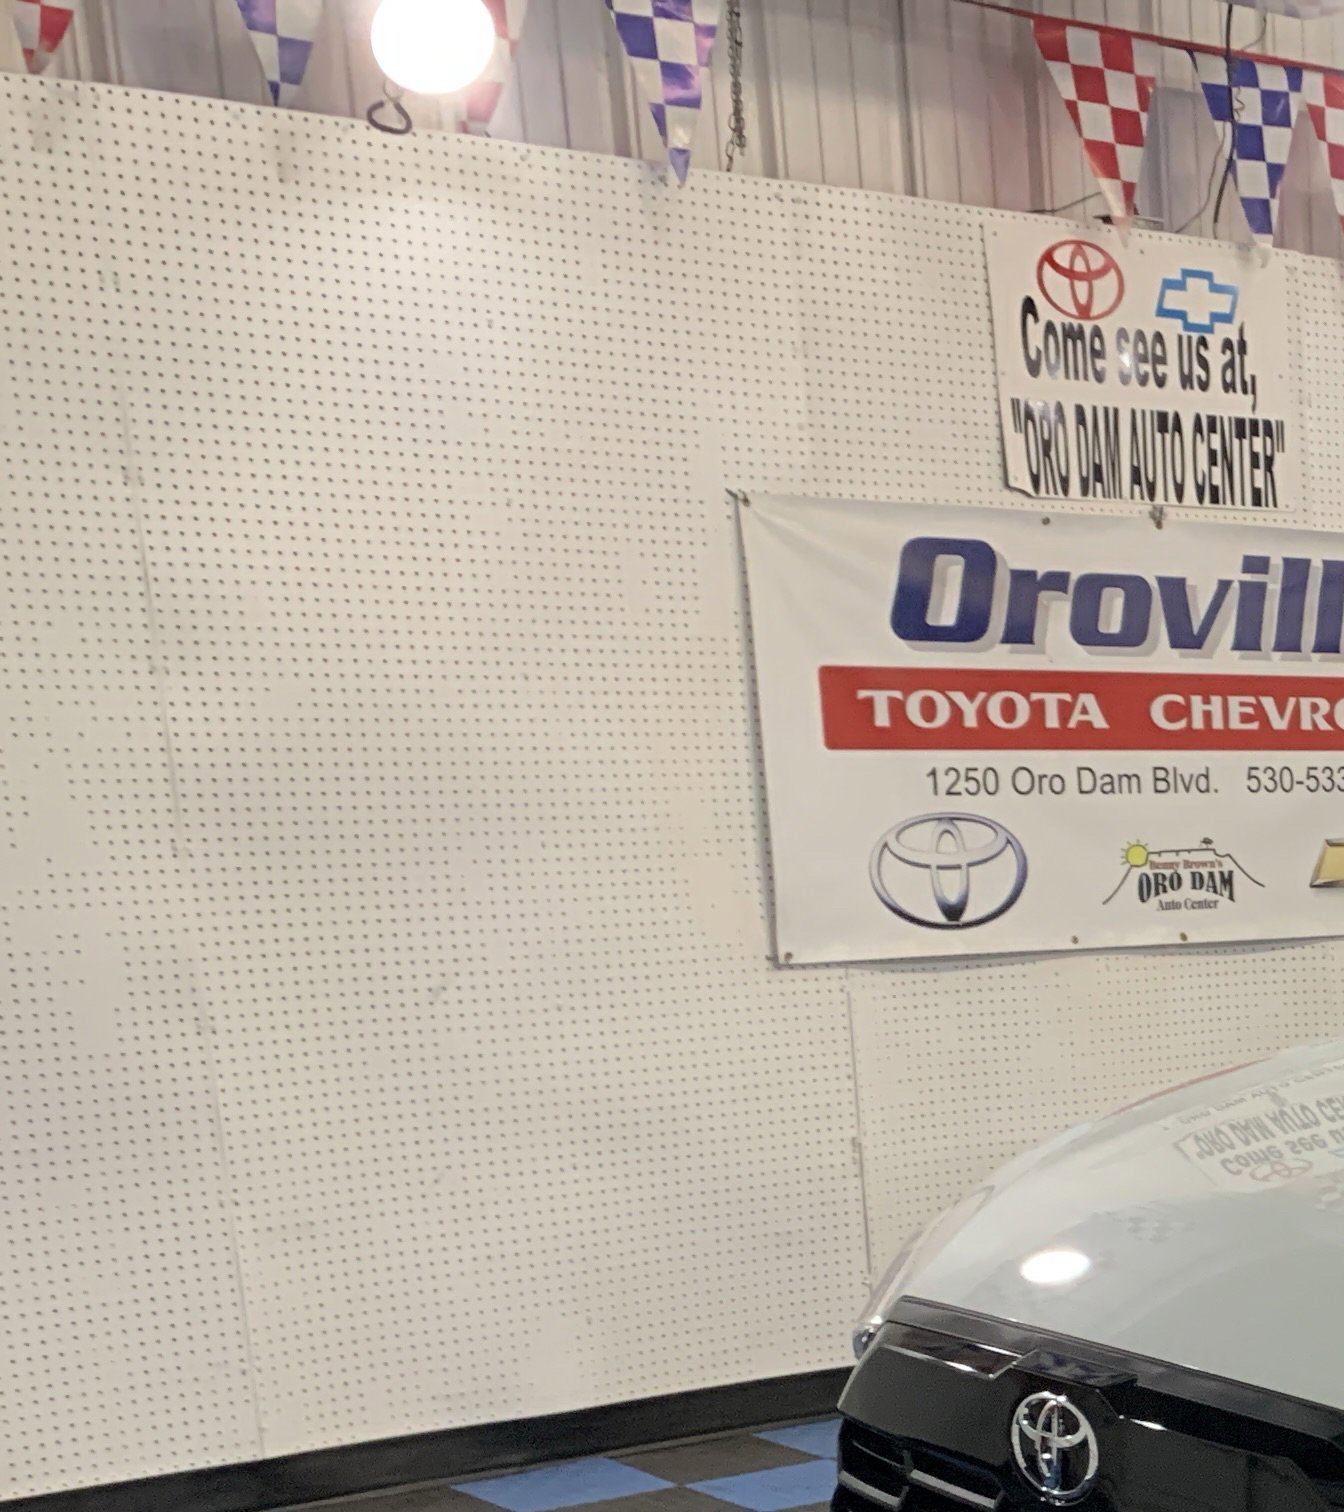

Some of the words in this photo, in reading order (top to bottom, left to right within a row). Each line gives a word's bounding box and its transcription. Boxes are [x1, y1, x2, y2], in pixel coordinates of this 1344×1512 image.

[1021, 295, 1106, 384] Come
[1116, 326, 1167, 389] see
[1177, 333, 1211, 392] us
[1220, 321, 1257, 414] at,
[1010, 397, 1071, 498] "ORO
[1074, 403, 1124, 500] DAM
[1130, 407, 1185, 504] AUTO
[1192, 411, 1285, 508] CENTER"
[856, 688, 1110, 731] TOYOTA
[925, 766, 1000, 797] 1250
[1011, 765, 1066, 796] Oro
[1076, 765, 1142, 795] Dam
[1152, 765, 1220, 795] Blvd.
[1138, 870, 1183, 903] ORO
[1190, 869, 1236, 903] DAM
[1156, 899, 1182, 911] Auto
[1184, 897, 1220, 911] Center
